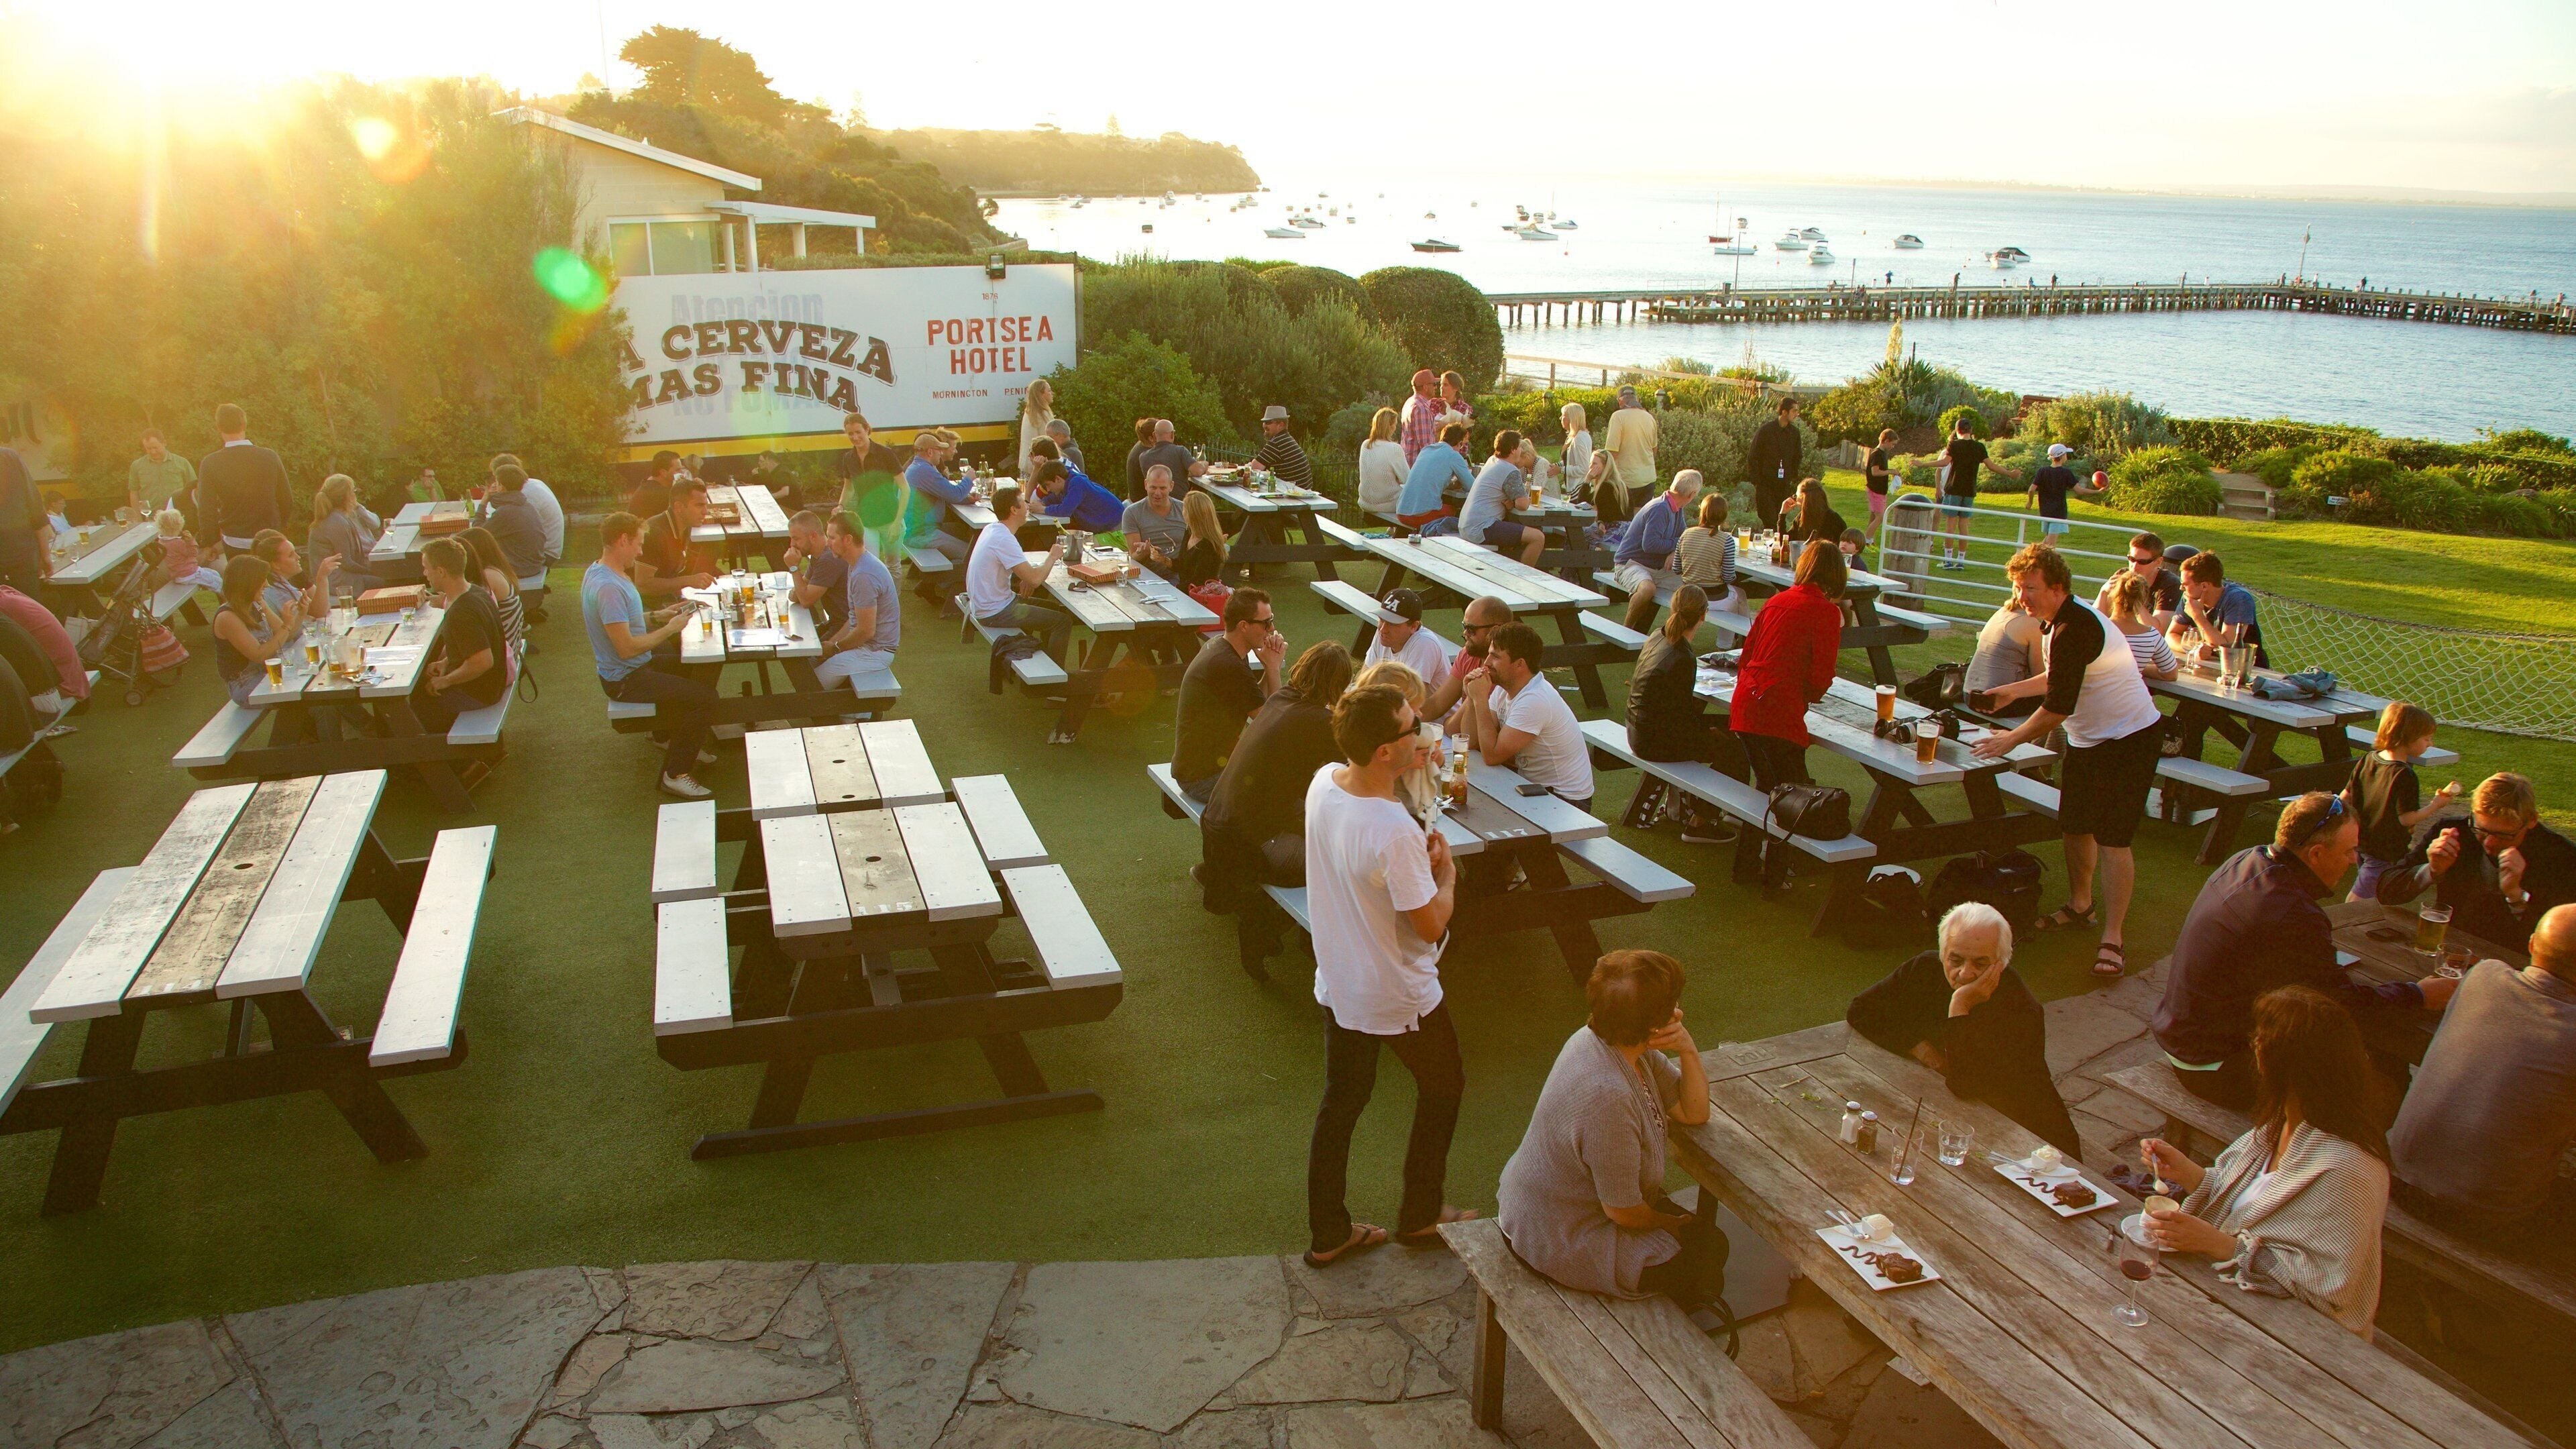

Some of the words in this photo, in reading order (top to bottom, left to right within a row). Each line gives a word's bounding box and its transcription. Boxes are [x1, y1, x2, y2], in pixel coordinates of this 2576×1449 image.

[928, 315, 1053, 345] PORTSEA
[661, 319, 898, 387] CERVEZA
[951, 347, 1032, 374] HOTEL
[741, 361, 861, 414] FINA
[932, 389, 987, 399] MORNINGTON
[1384, 594, 1400, 612] LA
[1485, 828, 1528, 839] 117
[857, 902, 913, 916] 115
